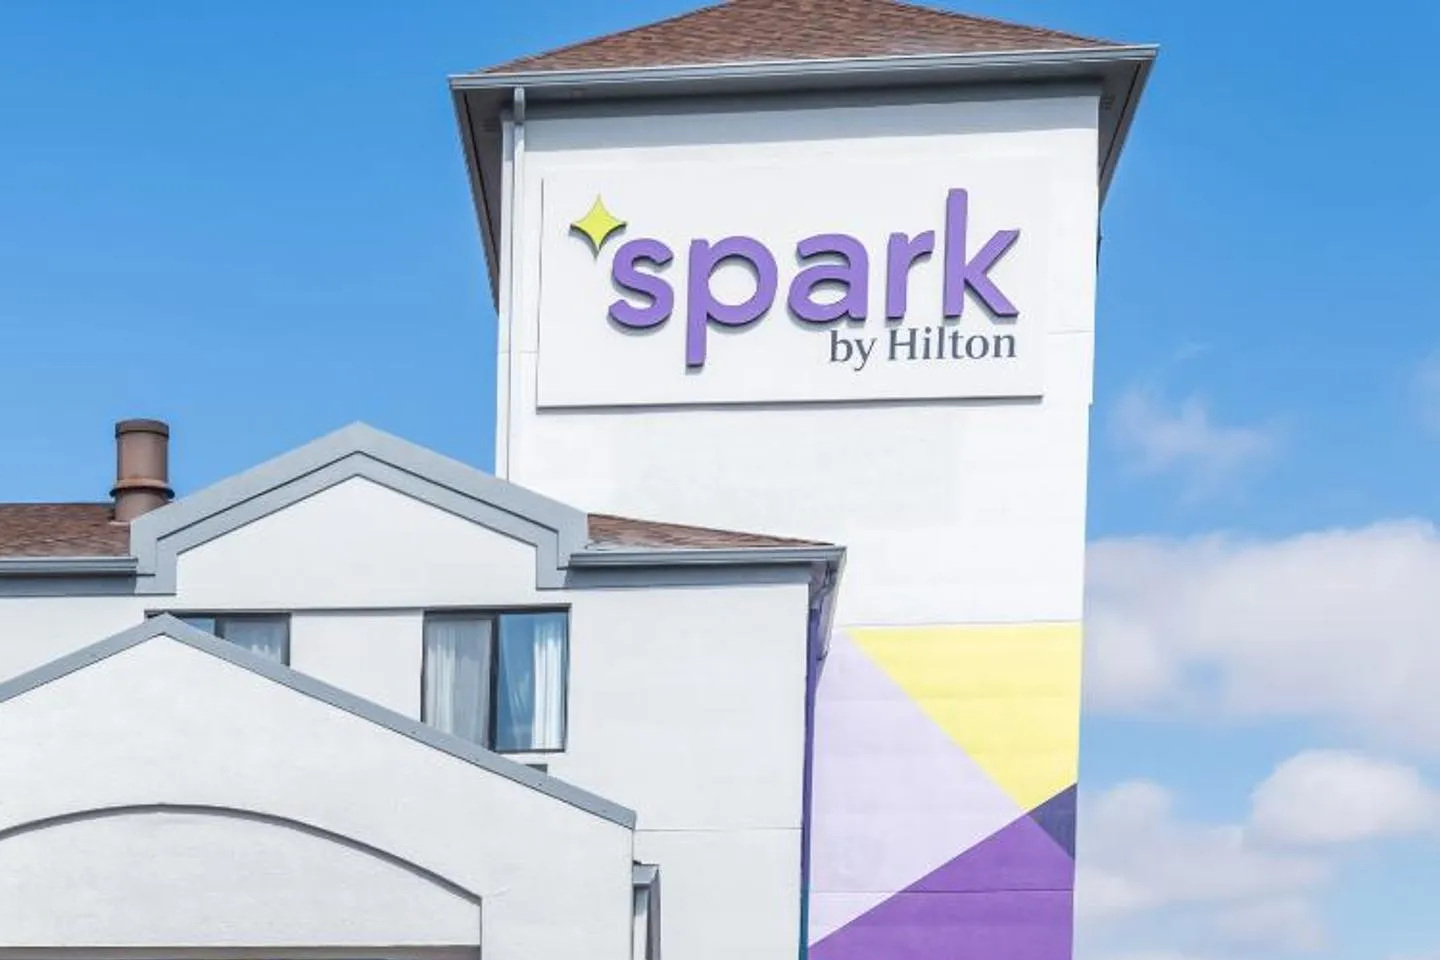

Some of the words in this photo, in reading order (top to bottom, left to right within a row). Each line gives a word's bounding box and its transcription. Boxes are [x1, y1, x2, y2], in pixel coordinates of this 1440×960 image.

[607, 187, 1020, 367] spark
[829, 330, 877, 372] by
[888, 326, 1016, 360] Hilton
